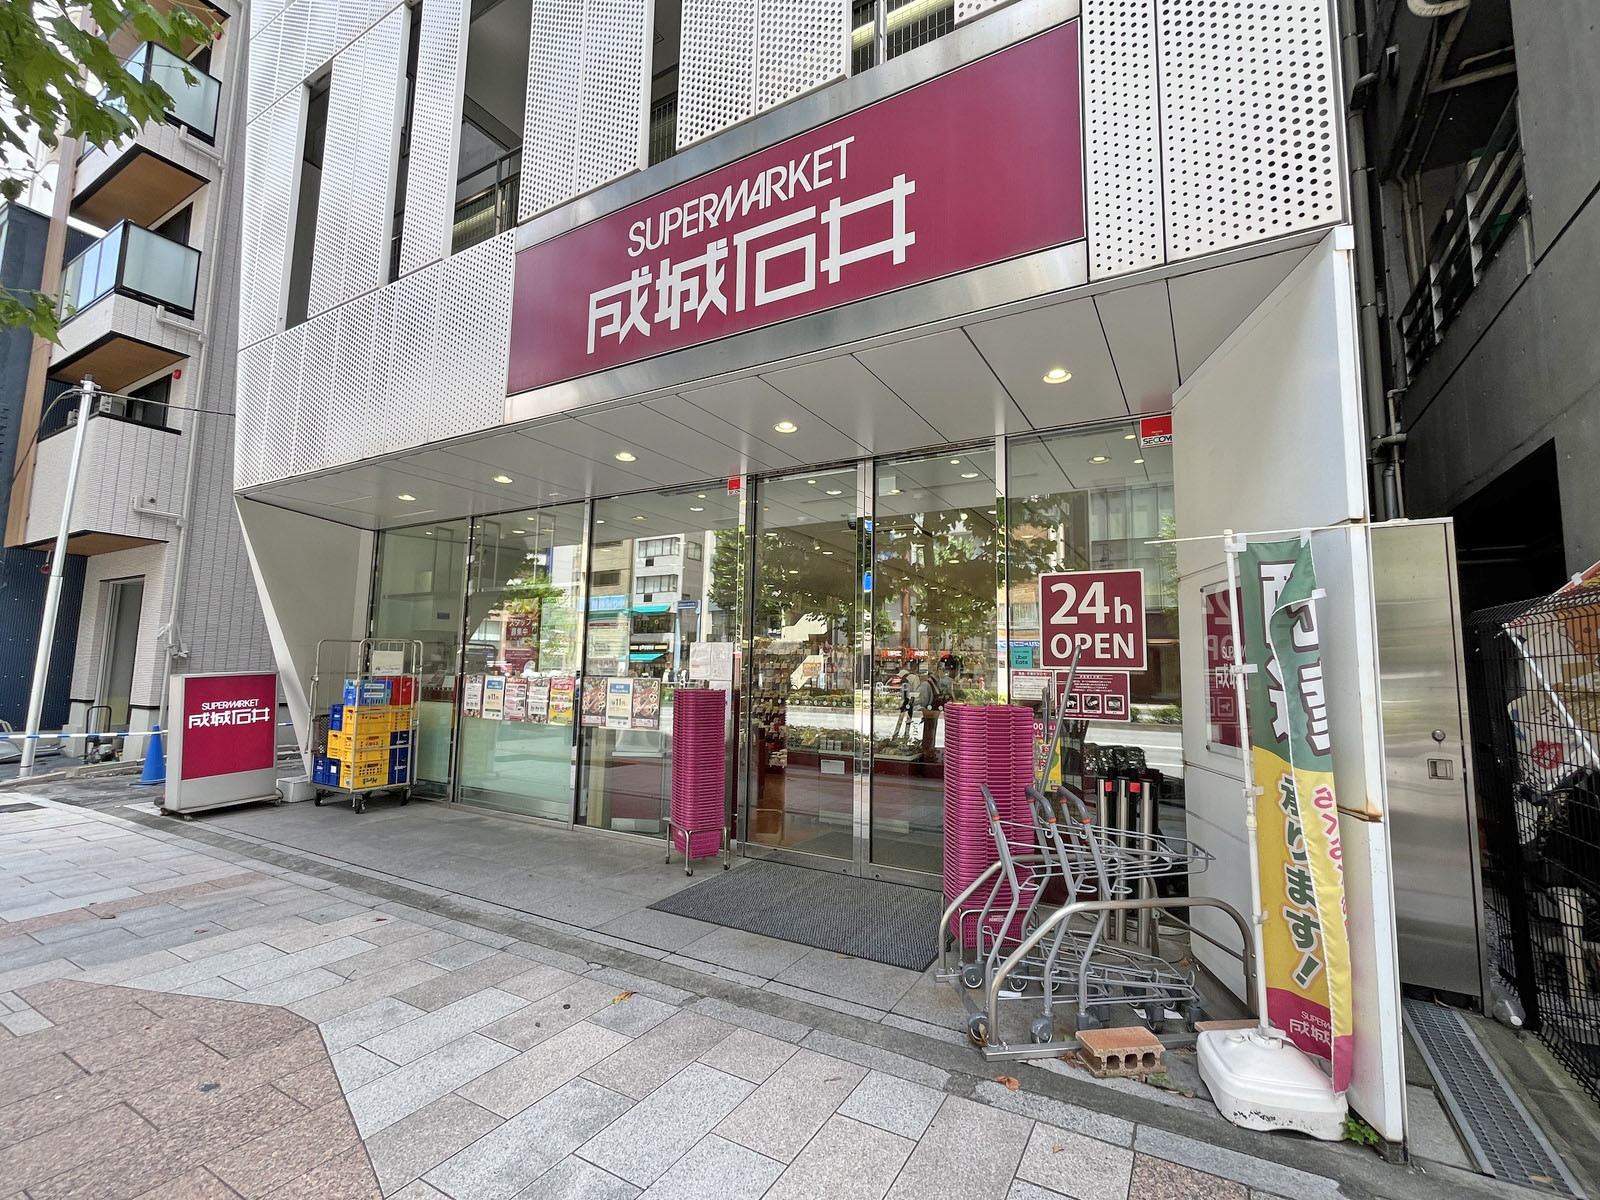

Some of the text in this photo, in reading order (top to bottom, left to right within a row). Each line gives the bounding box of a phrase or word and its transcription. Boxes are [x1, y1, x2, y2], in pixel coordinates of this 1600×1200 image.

[627, 136, 855, 258] SUPERMARKET
[586, 173, 916, 354] 成城石井
[1143, 435, 1173, 445] SECOM
[1050, 581, 1134, 625] 24h
[1050, 632, 1135, 659] OPEN
[188, 707, 270, 729] 成城石井
[201, 699, 259, 711] SUPERMARKET
